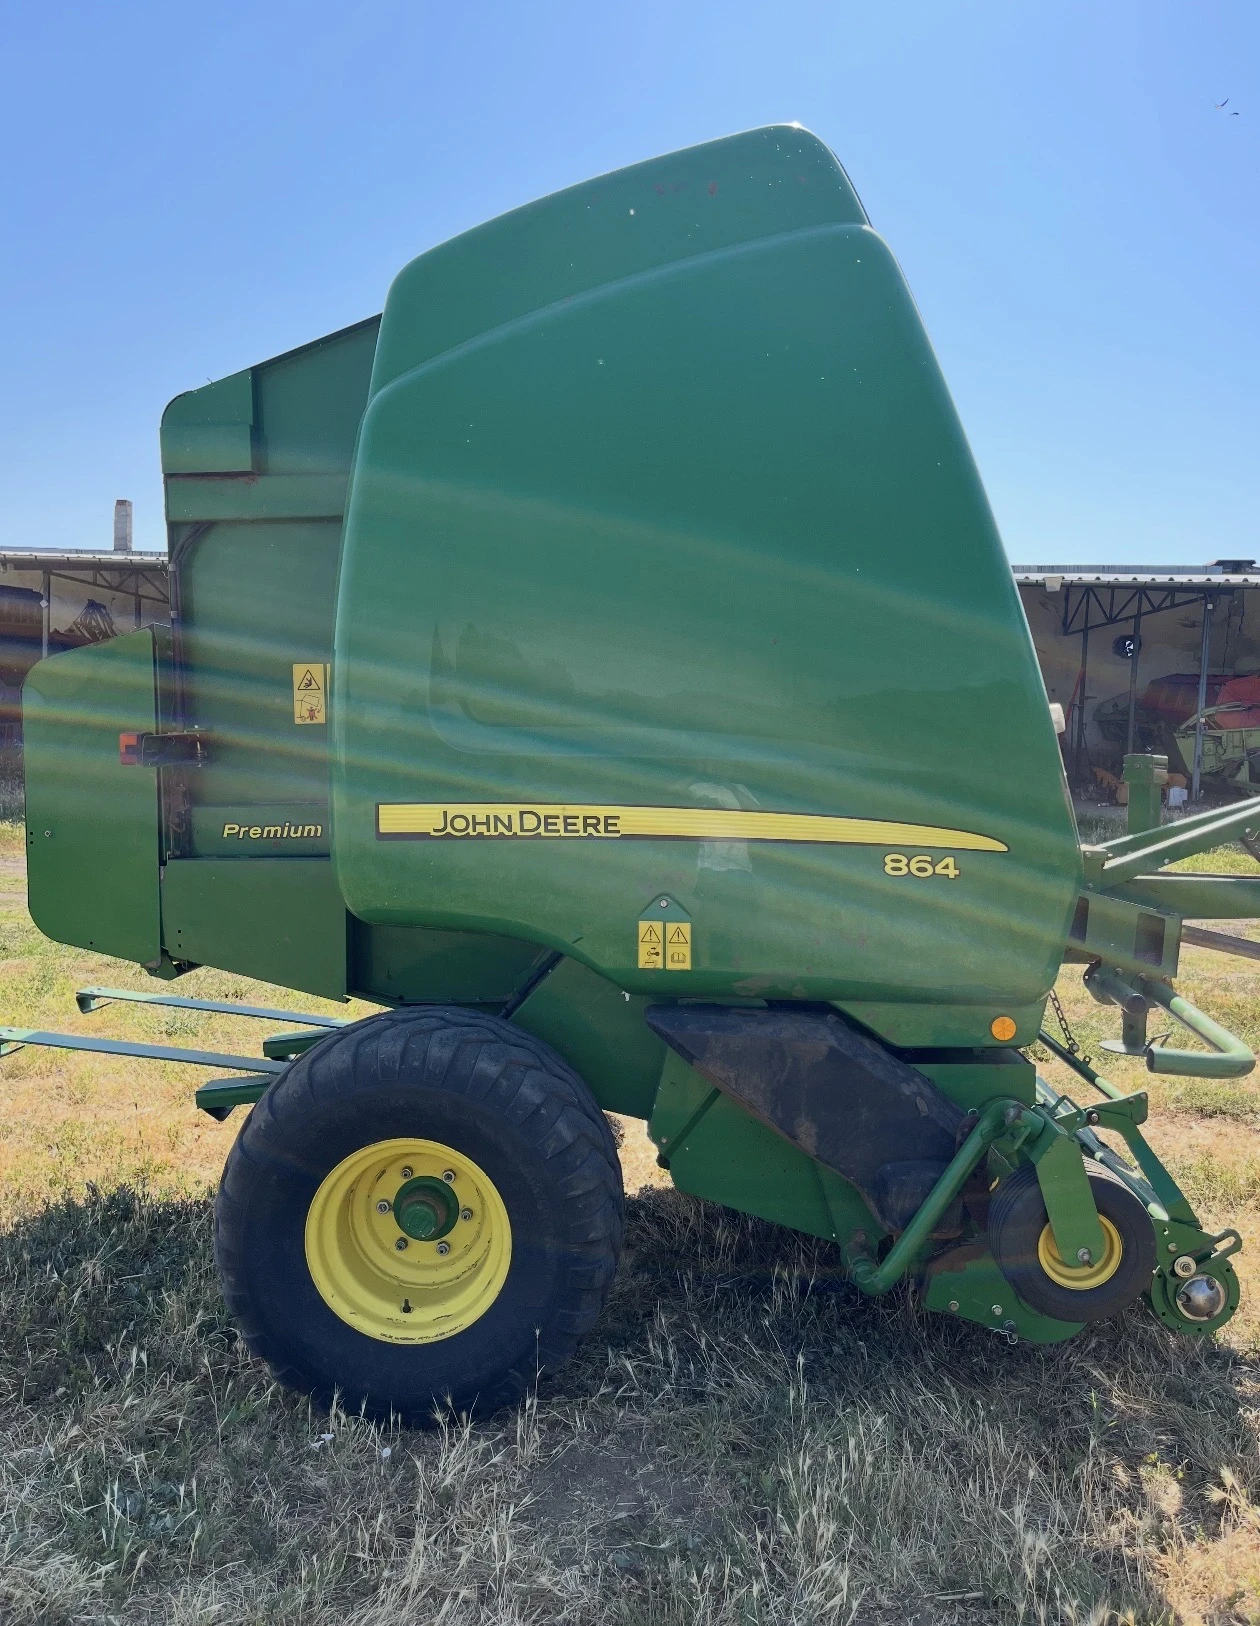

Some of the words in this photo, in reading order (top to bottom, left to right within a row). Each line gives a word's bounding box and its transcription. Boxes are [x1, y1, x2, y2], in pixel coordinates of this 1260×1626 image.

[222, 822, 322, 839] Premium
[432, 810, 513, 833] JOHN
[519, 810, 621, 834] DEERE
[883, 853, 960, 879] 864
